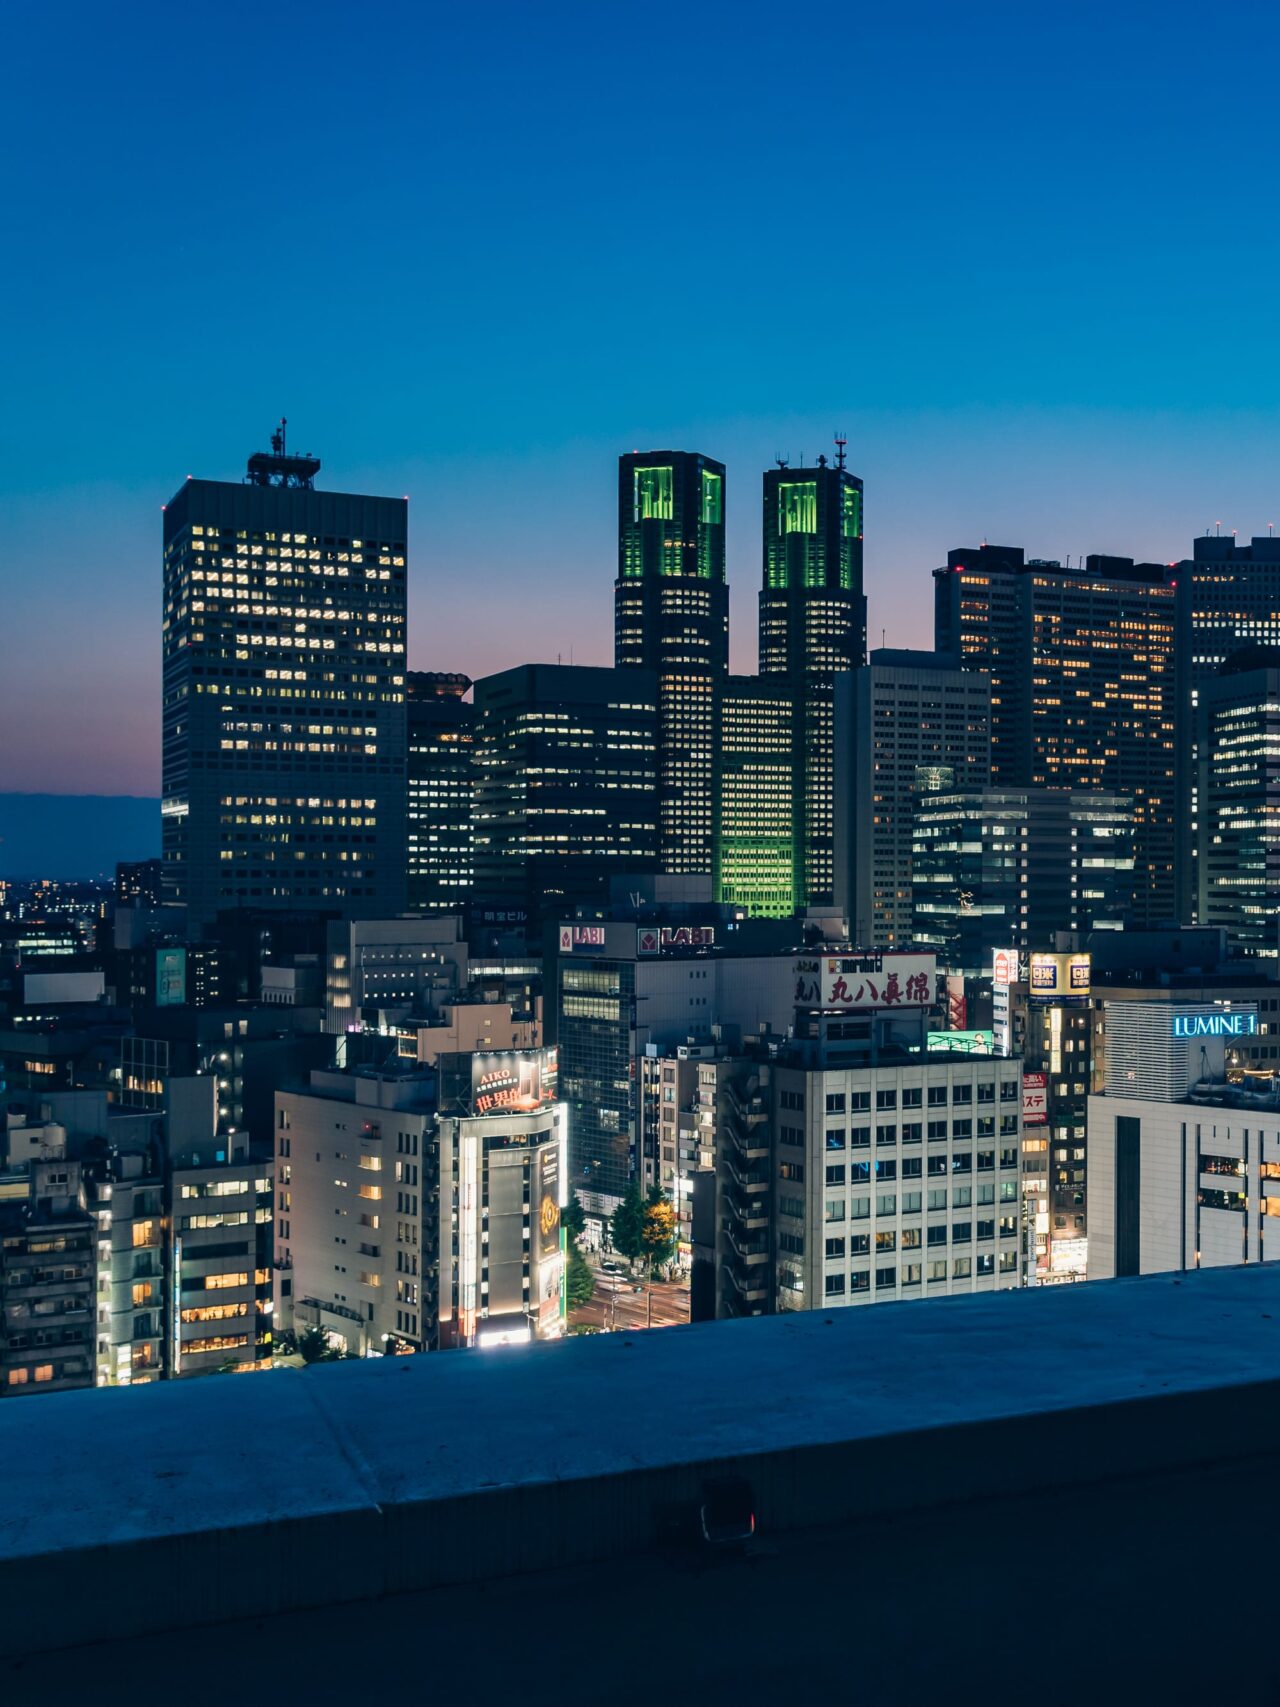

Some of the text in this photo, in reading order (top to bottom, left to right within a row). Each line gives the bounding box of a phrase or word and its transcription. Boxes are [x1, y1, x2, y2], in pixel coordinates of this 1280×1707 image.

[574, 927, 605, 945] LABI
[662, 927, 715, 945] LABI
[1175, 1015, 1255, 1036] LUMINE 1
[480, 1069, 511, 1085] AIKO
[1023, 1095, 1044, 1107] ステ
